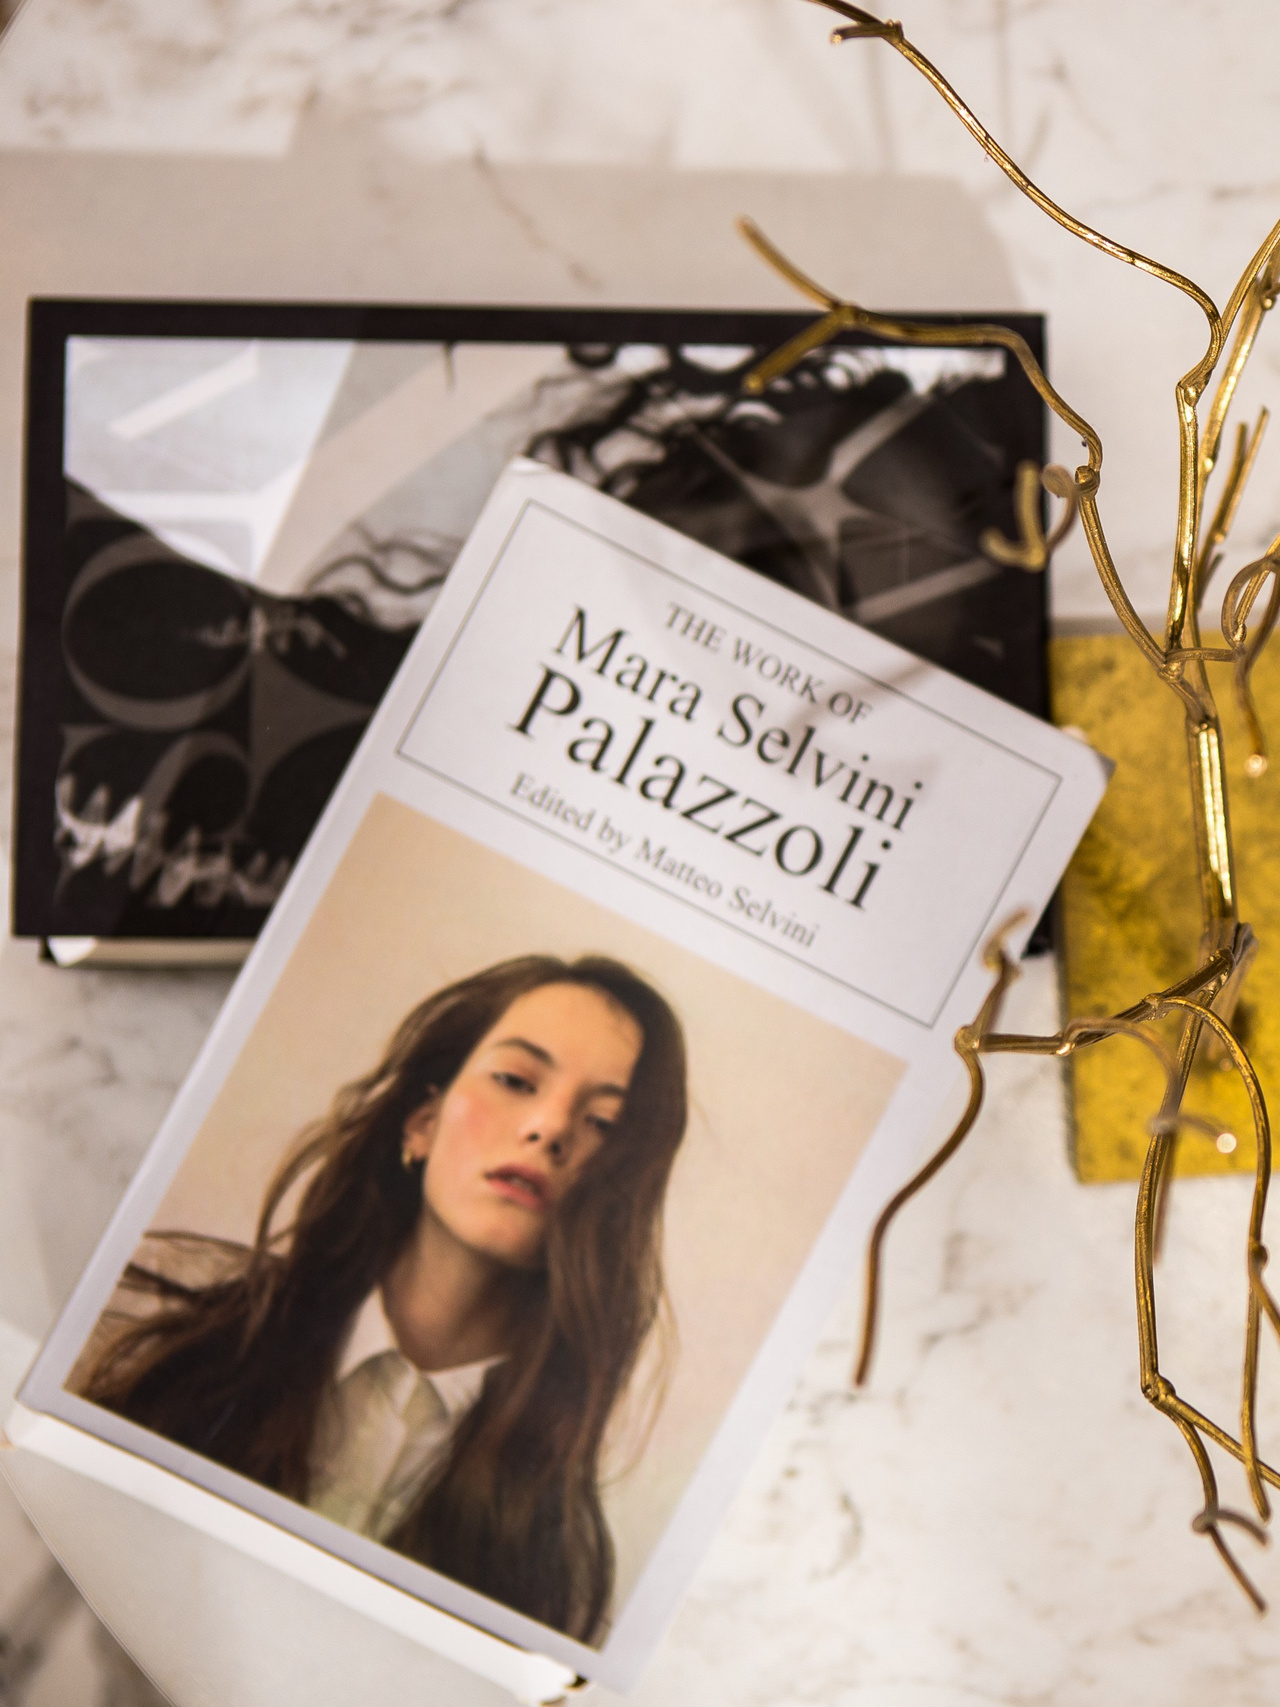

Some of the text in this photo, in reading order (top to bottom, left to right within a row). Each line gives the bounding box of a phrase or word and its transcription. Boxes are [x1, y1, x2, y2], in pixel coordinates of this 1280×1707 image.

[553, 604, 924, 833] Mara Selvini
[665, 602, 873, 726] THE WORK OF
[506, 663, 895, 912] Palazzoli
[509, 773, 821, 949] Edited by Matteo Selvini
